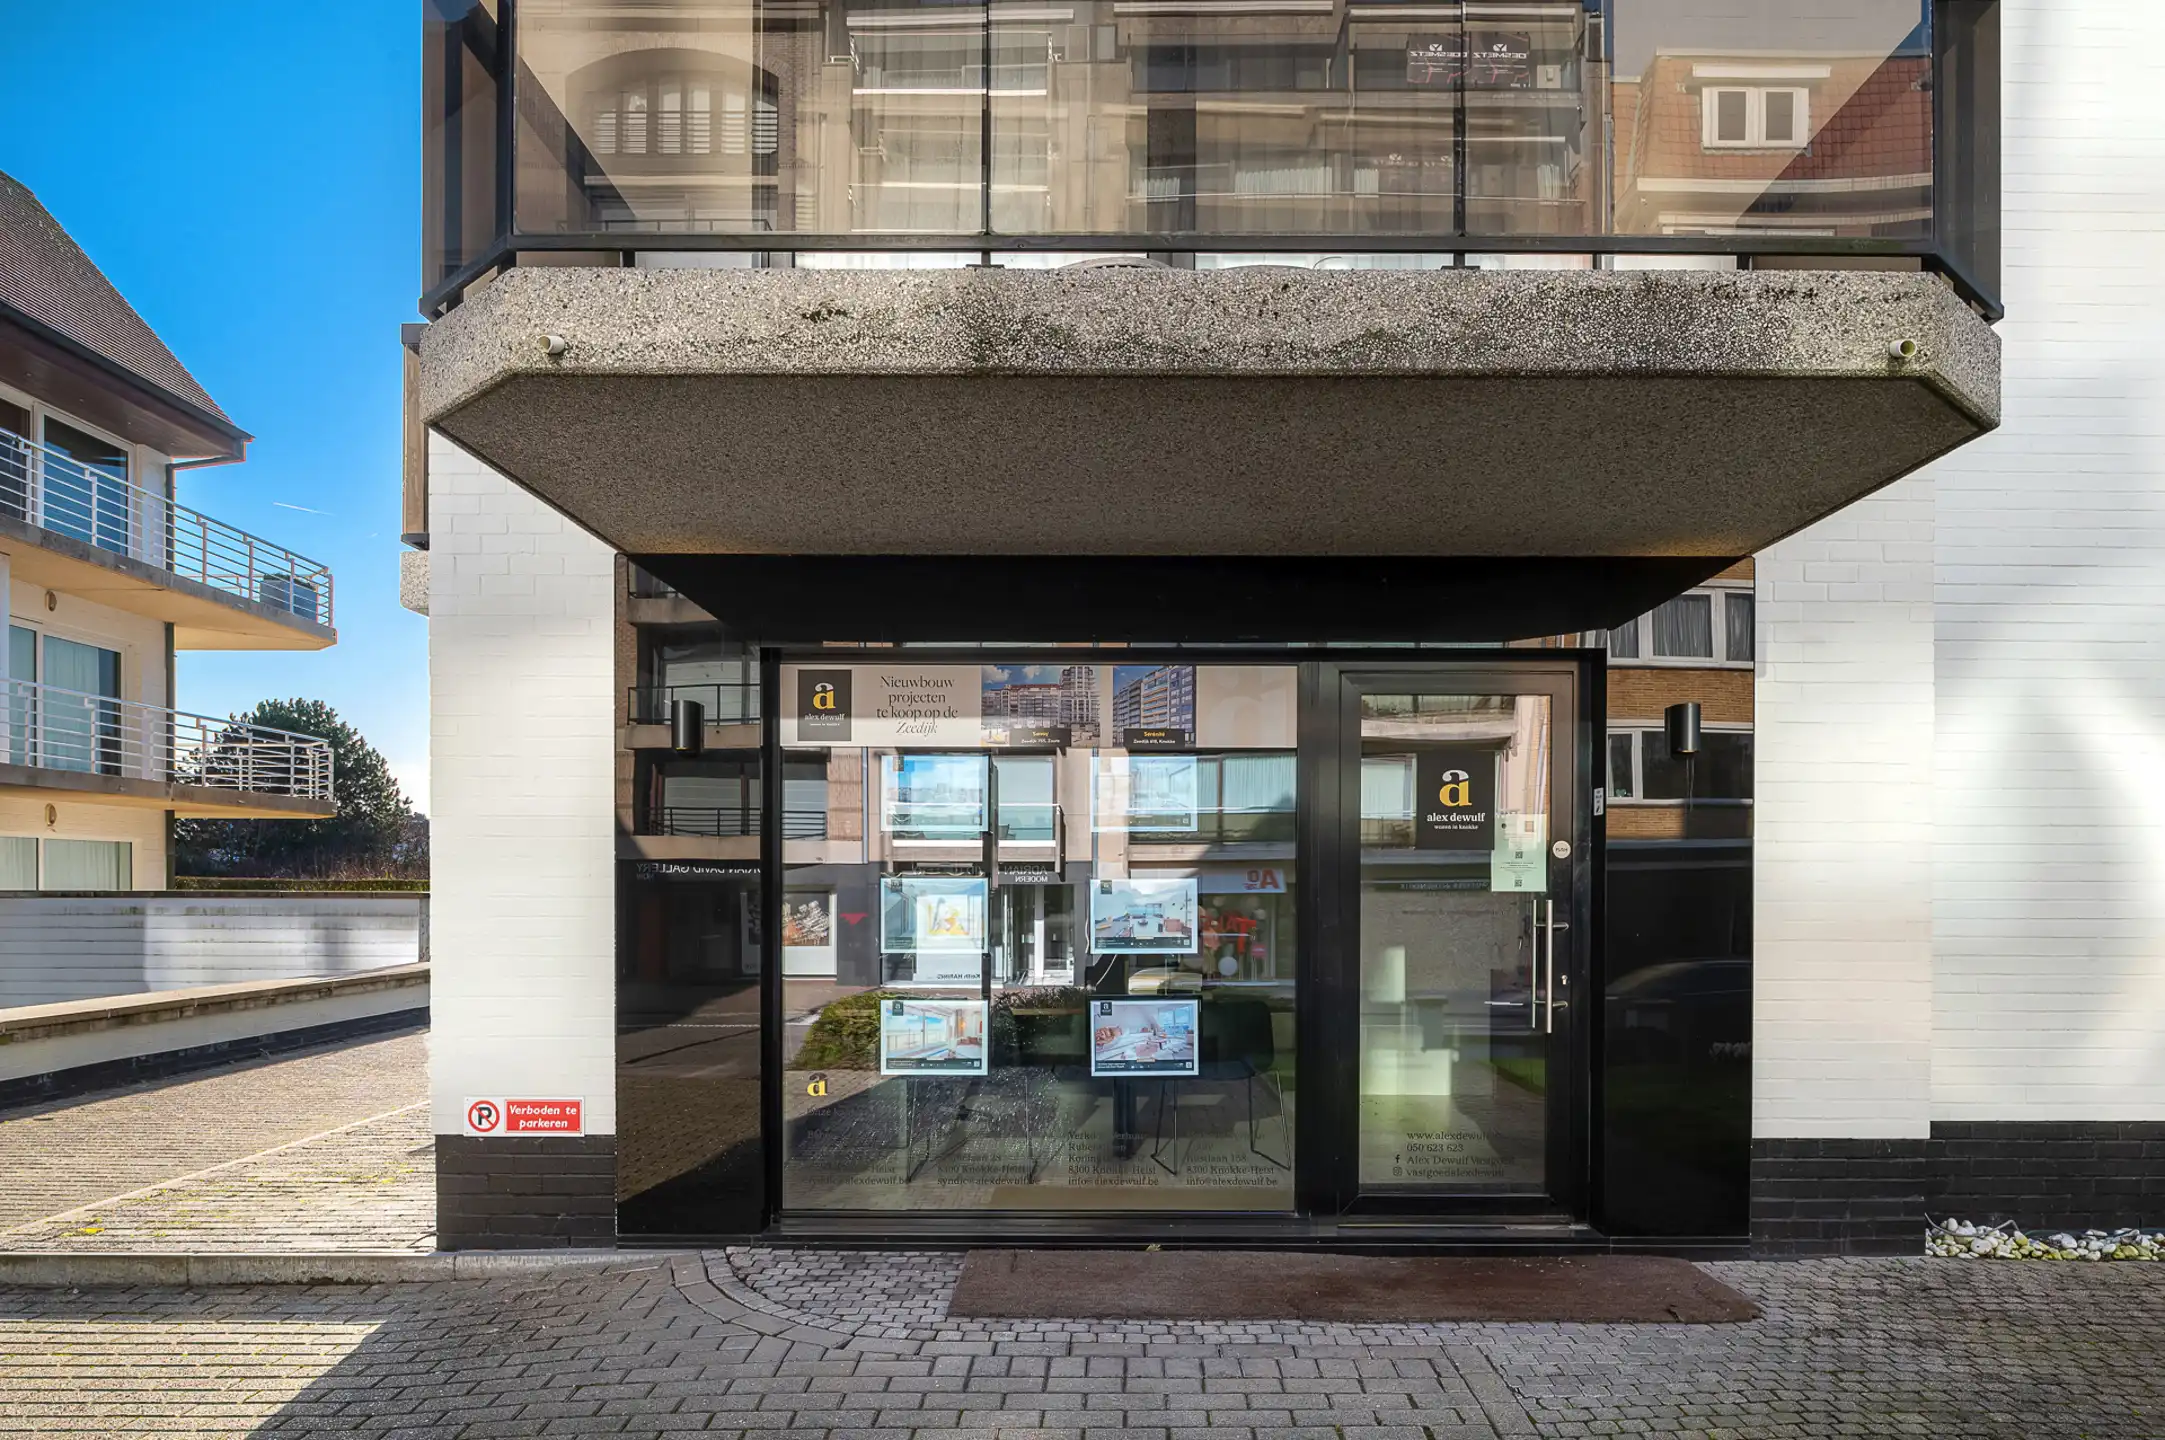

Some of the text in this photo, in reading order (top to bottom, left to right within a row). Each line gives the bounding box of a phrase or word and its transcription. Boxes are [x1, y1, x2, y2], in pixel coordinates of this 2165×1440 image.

[880, 676, 955, 688] Nieuwbouw
[888, 692, 946, 706] projecten
[804, 713, 845, 721] alex dewulf
[876, 706, 958, 722] te koop op de
[896, 722, 938, 738] Zeedijk
[1427, 812, 1486, 822] alex dewulf
[509, 1104, 577, 1116] Verboden te
[519, 1118, 568, 1130] parkeren
[1406, 1144, 1464, 1152] 050 623 623
[1406, 1156, 1430, 1165] Alex
[1433, 1156, 1469, 1165] Dewulf
[1068, 1166, 1090, 1175] 8300
[1186, 1166, 1275, 1175] 8300 Knokke-Heist
[1185, 1176, 1278, 1187] info@alexdewulf.be
